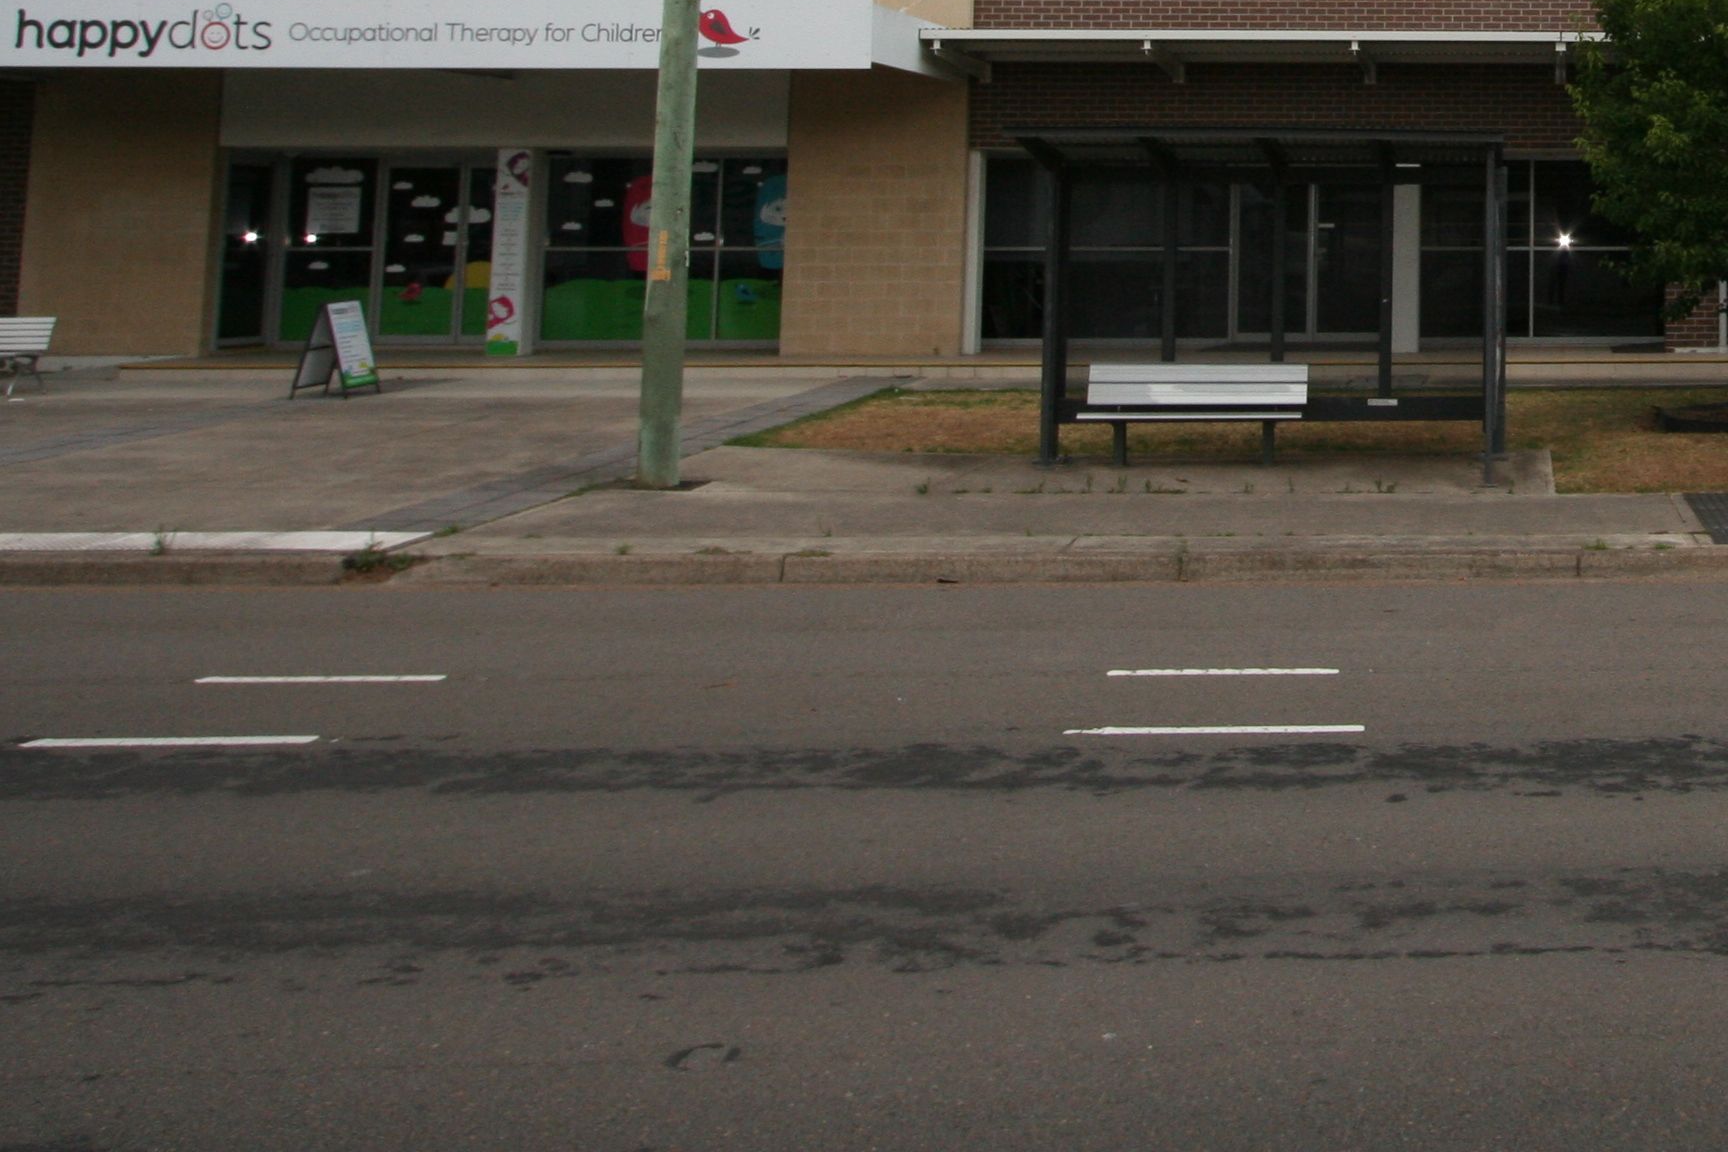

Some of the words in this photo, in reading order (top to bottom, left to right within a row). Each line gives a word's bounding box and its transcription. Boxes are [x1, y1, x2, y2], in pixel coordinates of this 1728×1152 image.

[14, 7, 273, 58] happydots
[288, 21, 439, 46] Occupational
[445, 22, 539, 47] Therapy
[544, 22, 576, 43] for
